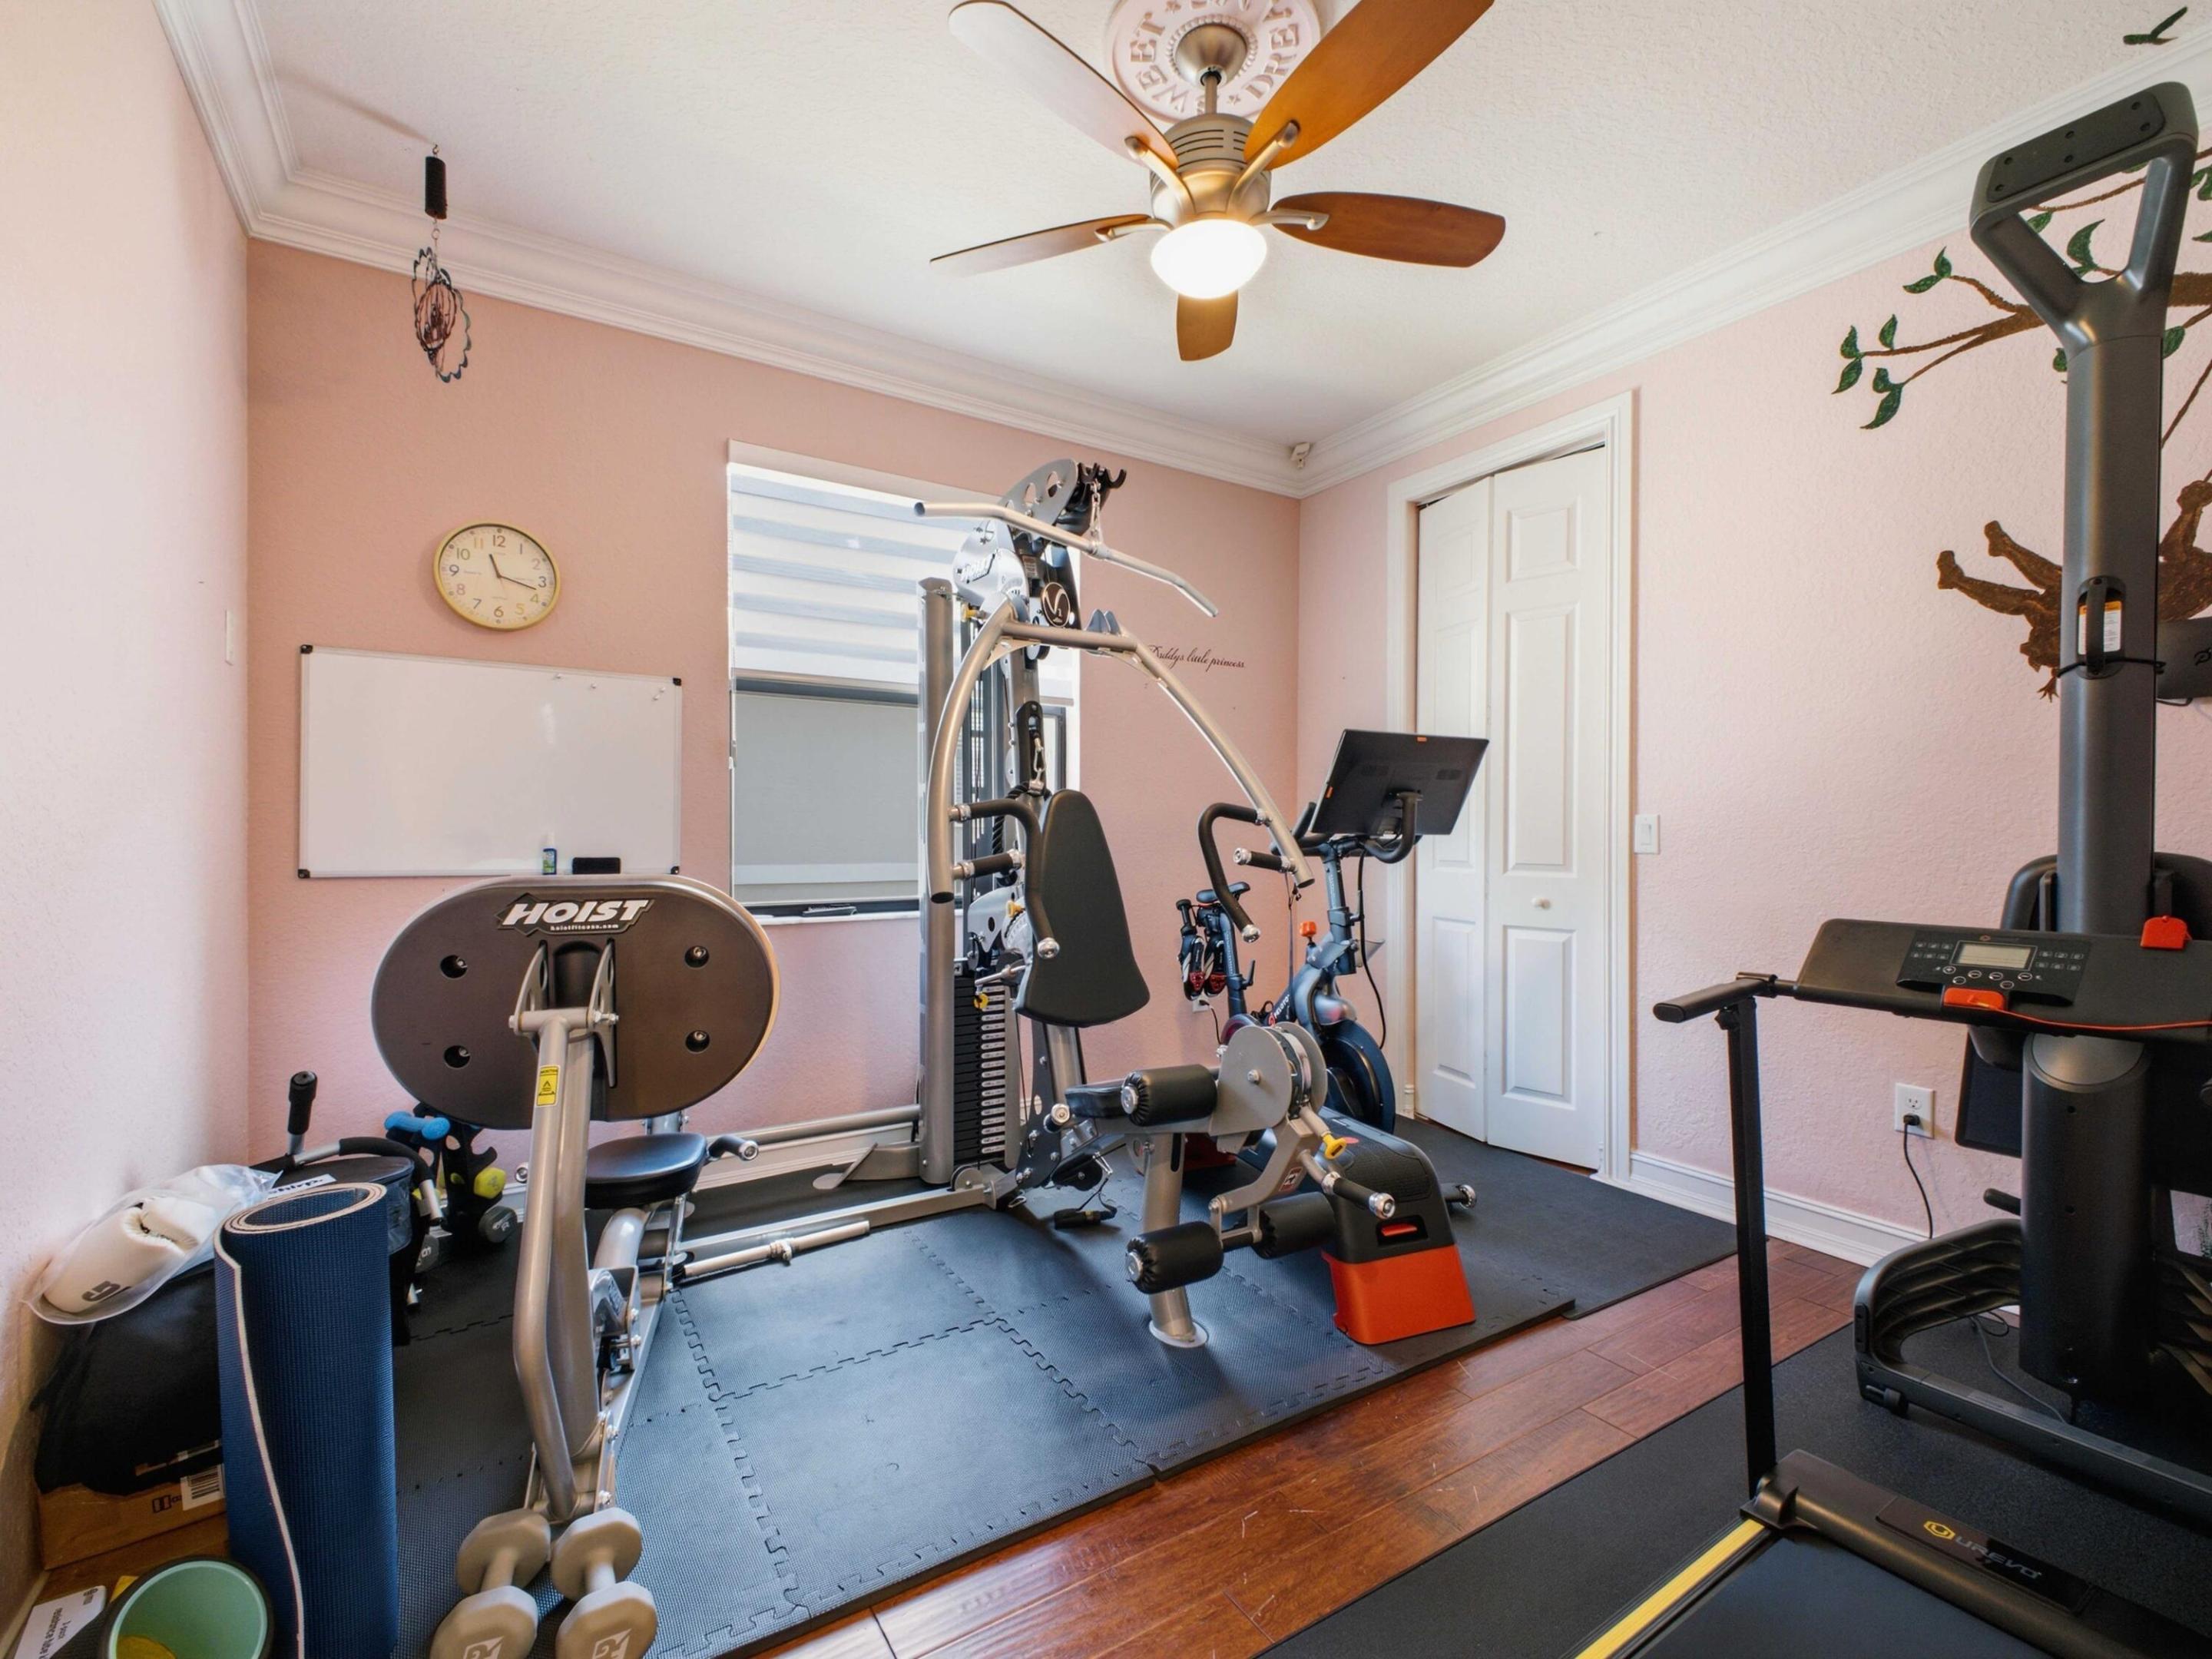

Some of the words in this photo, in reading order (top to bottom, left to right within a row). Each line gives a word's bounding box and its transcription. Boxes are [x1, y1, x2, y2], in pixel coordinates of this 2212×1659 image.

[473, 538, 485, 549] 11
[492, 535, 506, 548] 12
[456, 548, 470, 560] 10
[519, 543, 523, 555] 1
[531, 558, 540, 570] 2
[449, 565, 459, 576] 9
[538, 576, 547, 588] 3
[456, 584, 465, 595] 8
[473, 598, 482, 609] 7
[530, 594, 539, 604] 4
[494, 606, 504, 618] 6
[515, 603, 525, 615] 5
[1205, 657, 1244, 672] princess
[502, 899, 649, 926] HOIST
[1274, 994, 1290, 1019] PELOTO
[1955, 1536, 2038, 1579] UREVO
